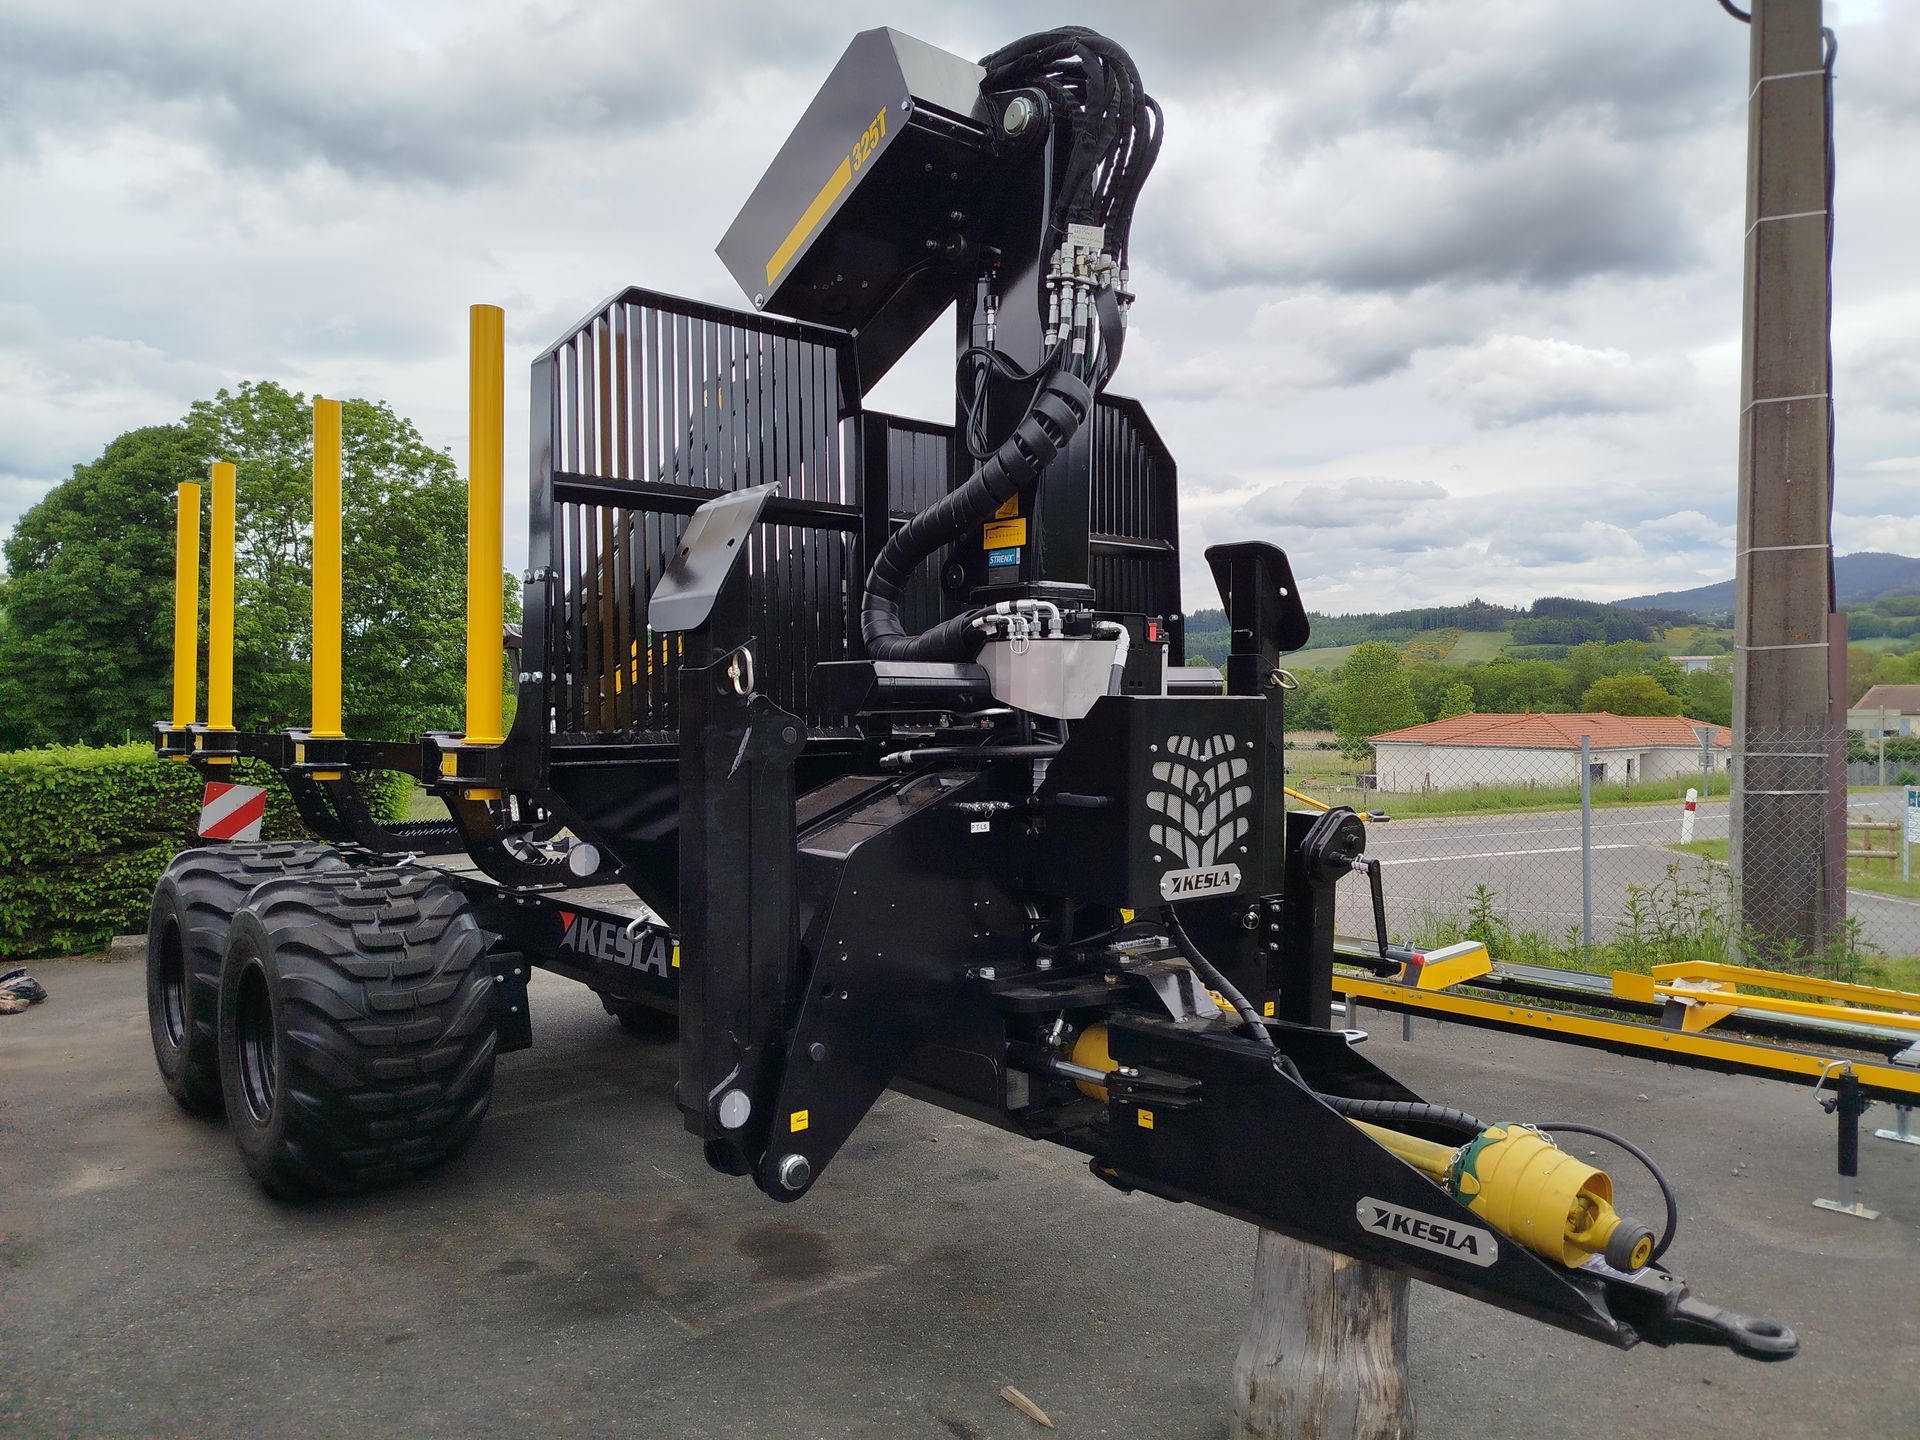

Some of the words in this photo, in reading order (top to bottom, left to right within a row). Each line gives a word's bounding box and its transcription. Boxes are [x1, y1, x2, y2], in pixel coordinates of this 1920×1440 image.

[852, 105, 887, 171] 325T
[990, 554, 1013, 564] STRENX
[1183, 871, 1230, 891] KESLA
[579, 917, 668, 978] KESLA
[1392, 1214, 1478, 1255] KESLA
